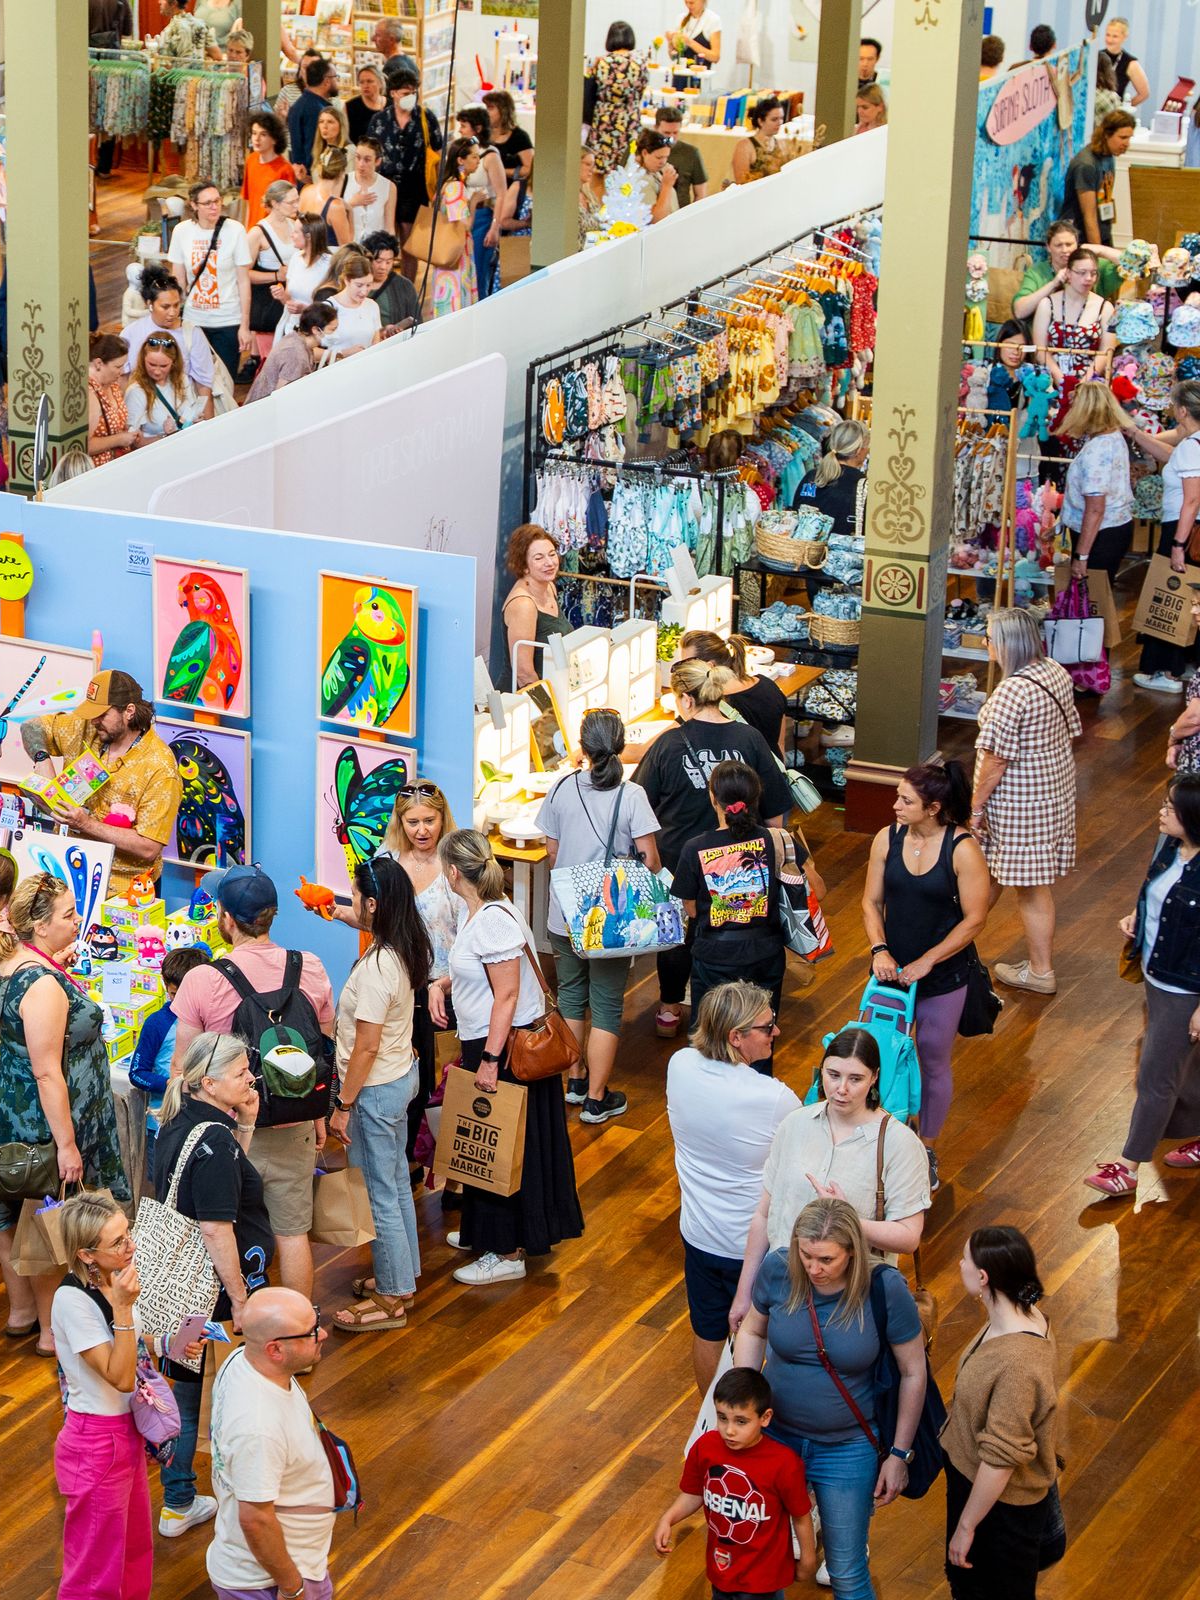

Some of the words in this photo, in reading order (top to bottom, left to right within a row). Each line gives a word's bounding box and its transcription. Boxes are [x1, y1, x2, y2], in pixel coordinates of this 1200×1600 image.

[128, 554, 150, 566] $290
[1163, 594, 1184, 612] BIG
[1148, 604, 1180, 623] DESIGN
[1145, 617, 1176, 634] MARKET
[726, 840, 764, 855] ANNUAL
[457, 1118, 472, 1129] THE
[472, 1124, 499, 1148] BIG
[453, 1138, 496, 1163] DESIGN
[450, 1157, 494, 1179] MARKET
[244, 1245, 266, 1290] 2
